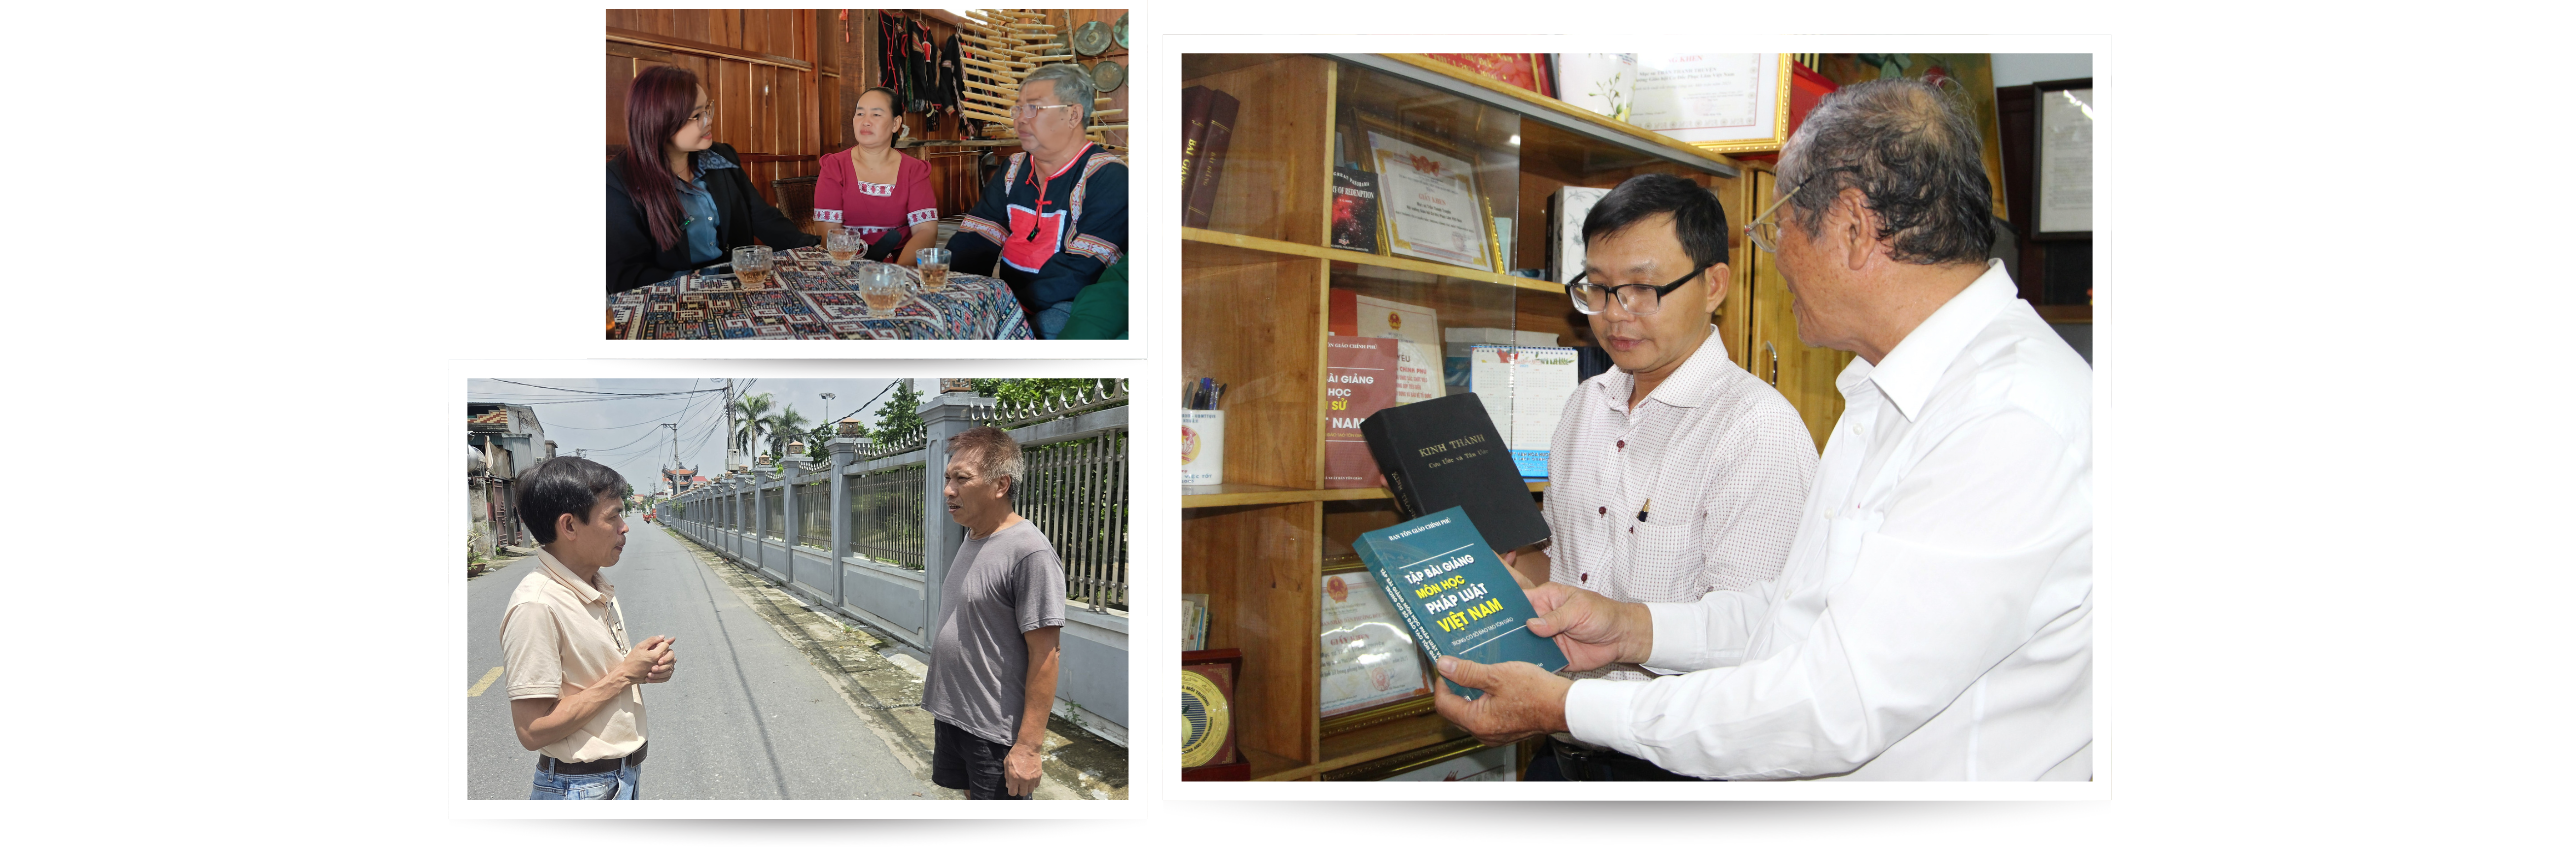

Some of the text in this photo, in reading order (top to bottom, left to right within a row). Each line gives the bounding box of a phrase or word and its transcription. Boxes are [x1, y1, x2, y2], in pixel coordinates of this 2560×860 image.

[1679, 55, 1703, 63] KHEN
[1338, 186, 1345, 194] OF
[1345, 187, 1374, 199] REDEMPTION
[1327, 372, 1374, 385] ÀI GIẢNG
[1328, 388, 1352, 399] HỌC
[1332, 397, 1348, 411] SỬ
[1332, 417, 1365, 429] NAM
[1418, 435, 1485, 457] KINH THÁNH
[1400, 530, 1413, 538] TÔN
[1411, 525, 1426, 534] GIÁO
[1424, 522, 1442, 530] CHÍNH
[1440, 516, 1452, 525] PHỦ
[1404, 554, 1475, 585] TẬP BÀI GIẢNG
[1415, 575, 1465, 599] MÔN HỌC
[1425, 583, 1488, 615] PHÁP LUẬT
[1380, 568, 1388, 578] TẬP
[1386, 577, 1394, 587] BÀI
[1392, 586, 1405, 603] GIẢNG
[1402, 602, 1413, 616] MÔN
[1410, 613, 1421, 627] HỌC
[1419, 626, 1430, 640] PHÁP
[1428, 639, 1438, 652] LUẬT
[1436, 597, 1504, 633] VIỆT NAM
[1385, 585, 1398, 603] TRONG
[1396, 602, 1404, 611] CƠ
[1401, 610, 1409, 619] SỞ
[1407, 618, 1416, 630] ĐÀO
[1414, 629, 1423, 640] TẠO
[1421, 639, 1431, 652] TÔN
[1429, 650, 1438, 664] GIÁ
[1330, 635, 1348, 646] GIẤY
[1451, 637, 1466, 646] TRONG
